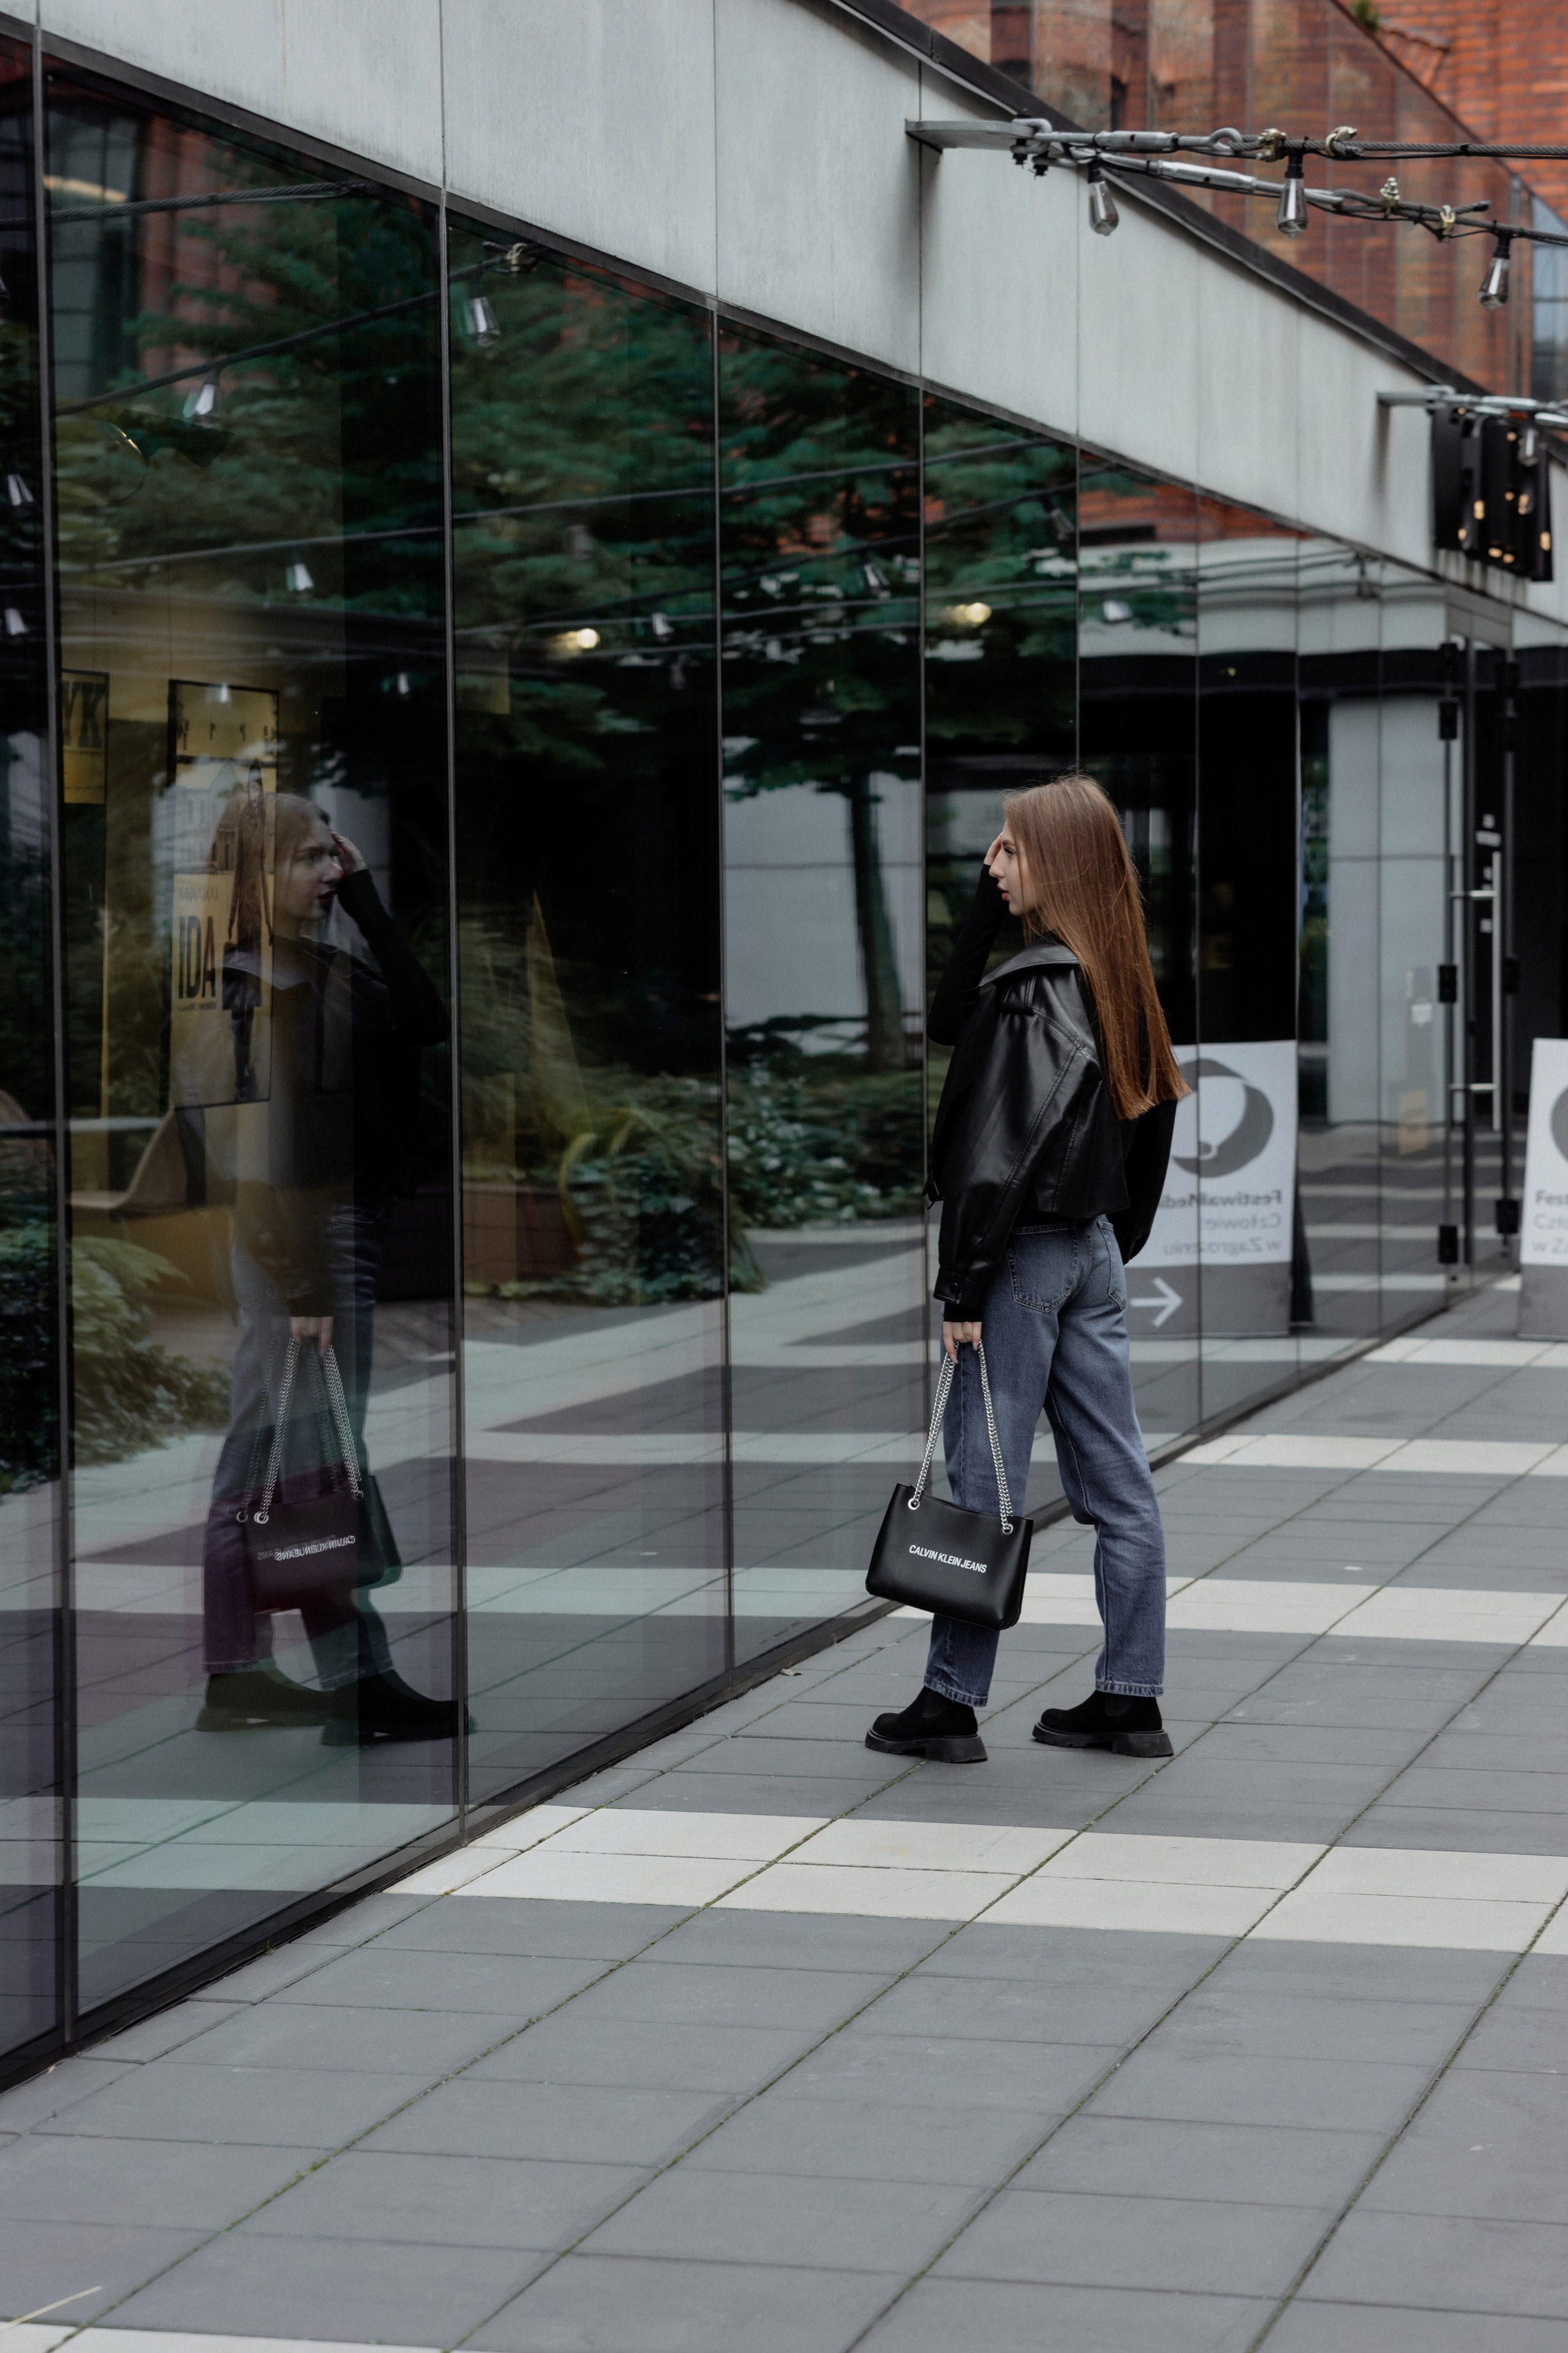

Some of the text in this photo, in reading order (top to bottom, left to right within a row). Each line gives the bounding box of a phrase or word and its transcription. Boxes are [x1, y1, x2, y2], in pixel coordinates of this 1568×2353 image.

[909, 1544, 987, 1573] CALVIN KLEIN JEANS
